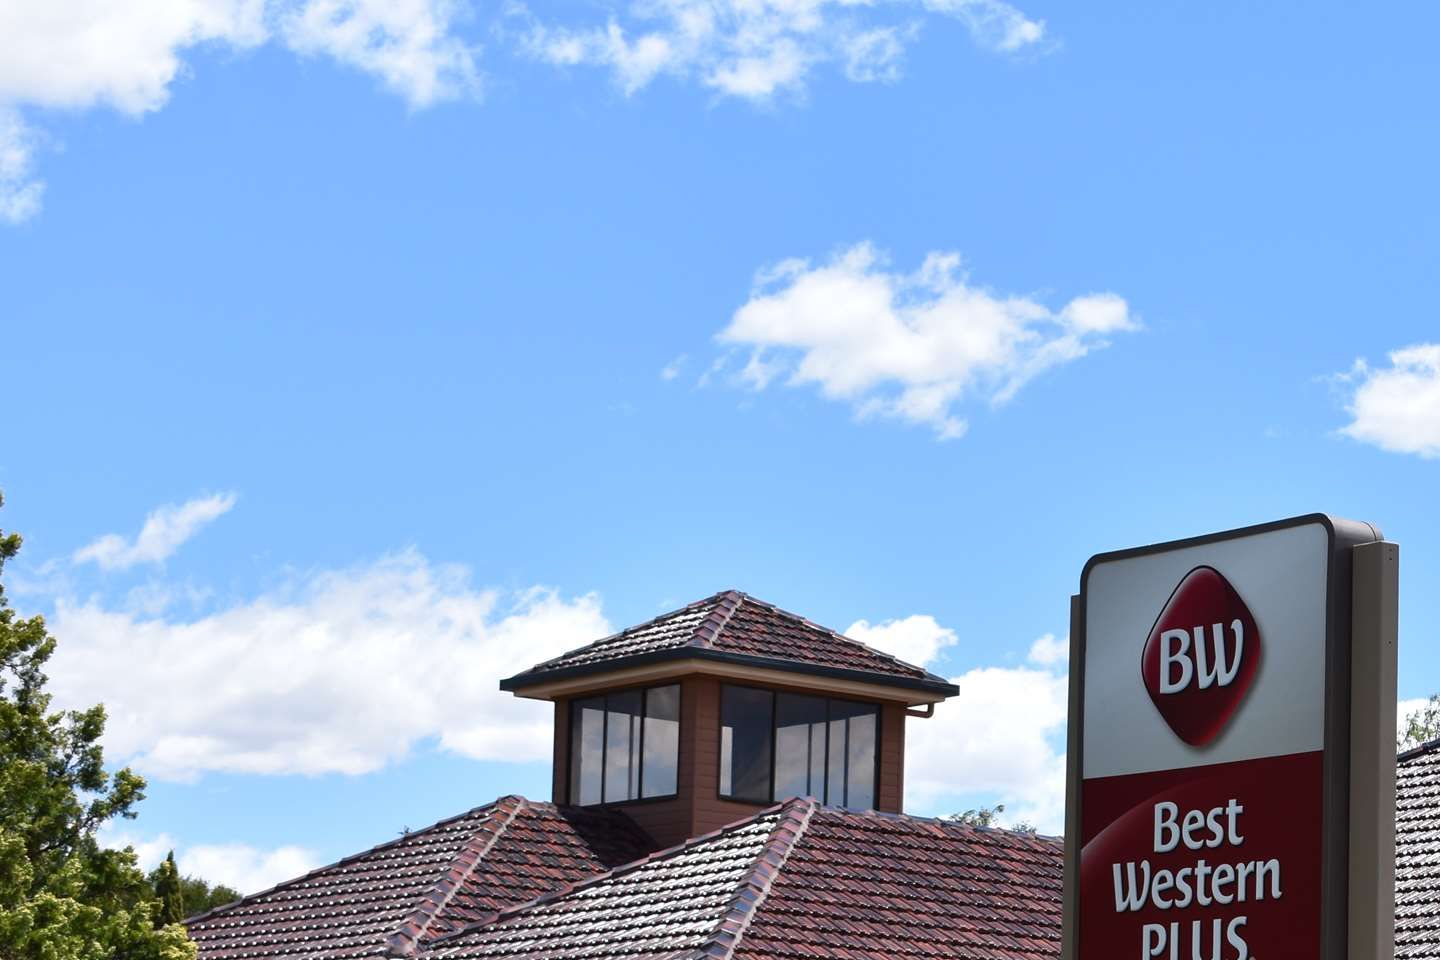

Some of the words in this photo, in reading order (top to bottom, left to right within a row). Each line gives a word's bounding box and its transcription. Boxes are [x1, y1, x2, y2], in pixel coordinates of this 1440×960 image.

[1159, 618, 1244, 695] BW
[1153, 798, 1245, 853] Best
[1112, 858, 1282, 913] Western
